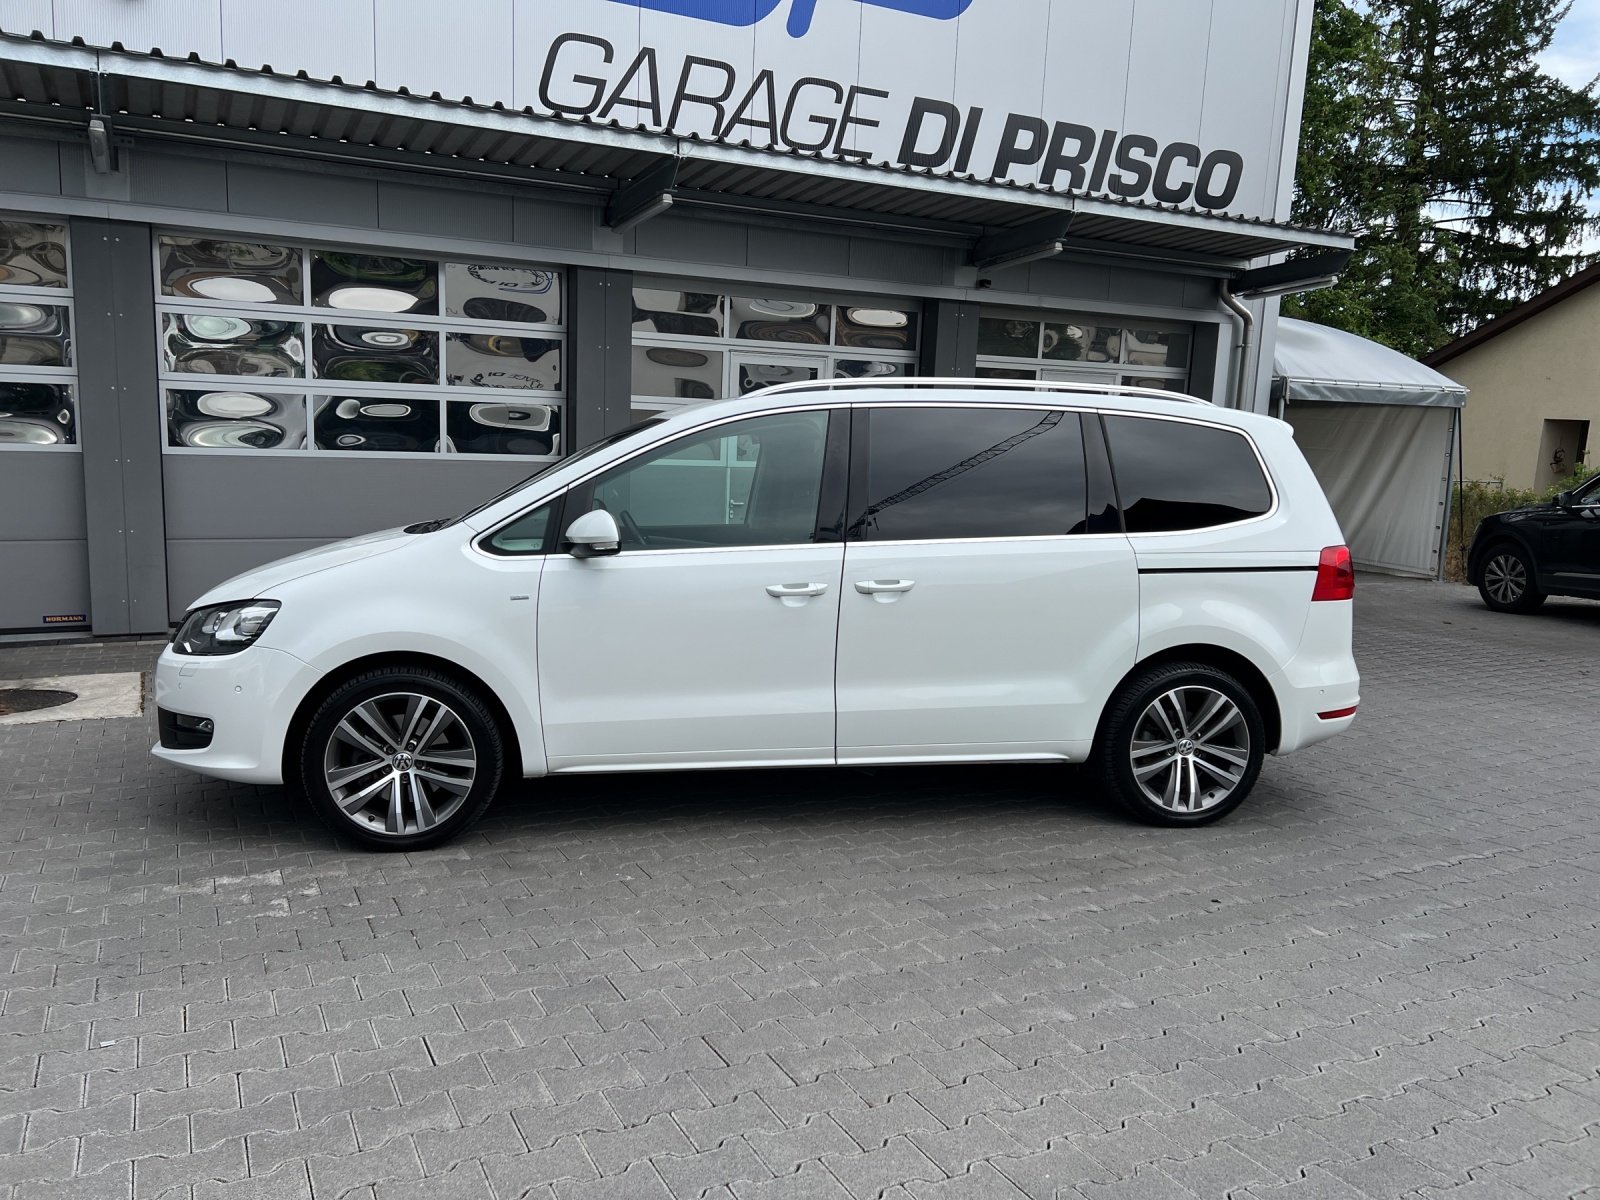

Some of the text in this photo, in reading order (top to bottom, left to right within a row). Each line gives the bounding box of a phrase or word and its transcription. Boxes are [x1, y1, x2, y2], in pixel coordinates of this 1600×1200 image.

[538, 32, 1244, 210] GARAGE DI PRISCO
